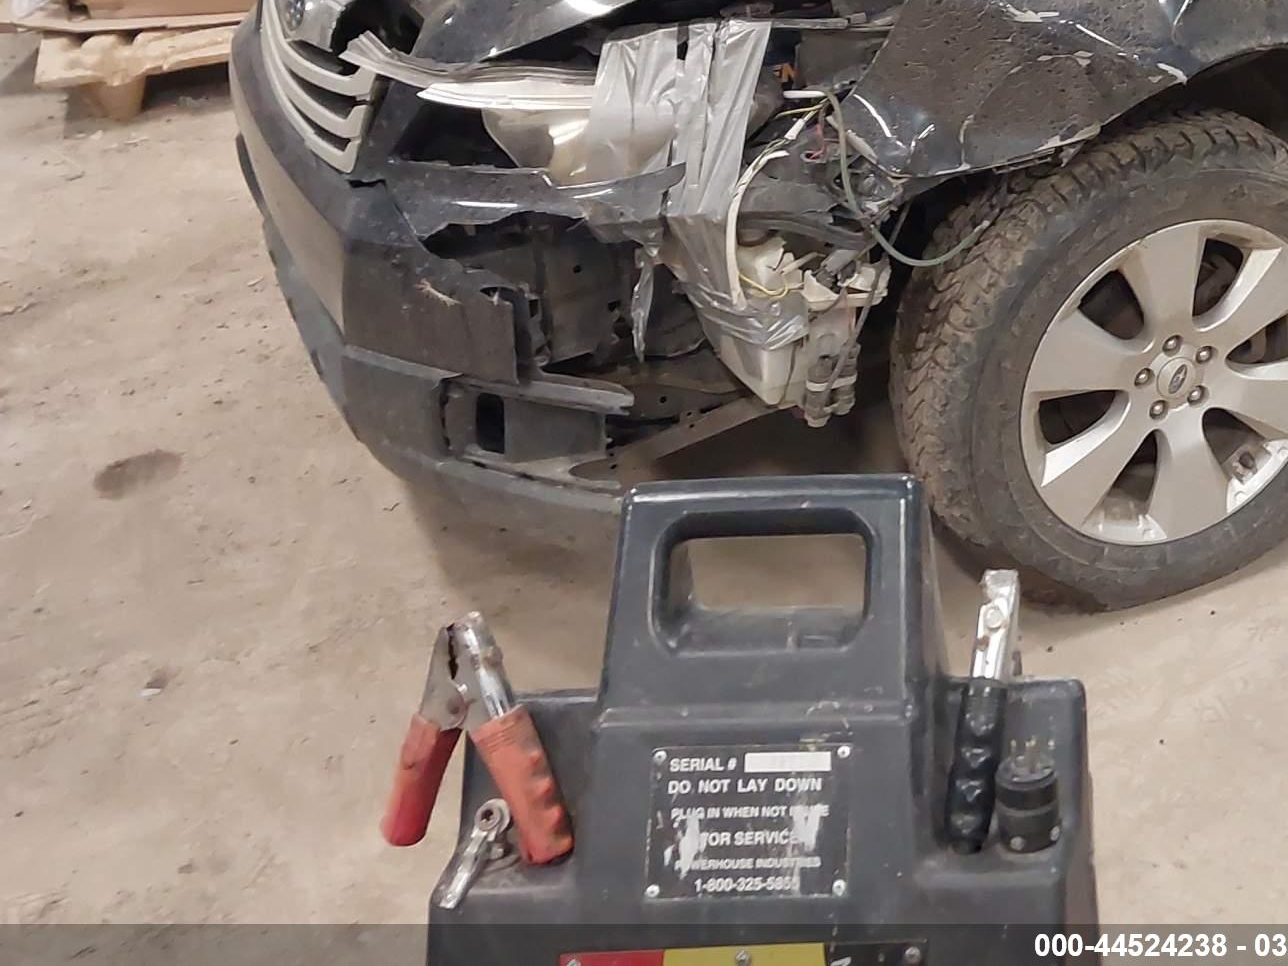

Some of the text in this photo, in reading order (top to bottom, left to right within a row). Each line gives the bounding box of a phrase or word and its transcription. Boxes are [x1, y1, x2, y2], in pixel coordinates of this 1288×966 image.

[669, 757, 737, 772] SERIAL #
[667, 777, 822, 794] DO NOT LAY DOWN
[670, 807, 705, 819] PLUG
[707, 807, 720, 818] IN
[722, 806, 760, 818] WHEN
[761, 805, 787, 817] NOT
